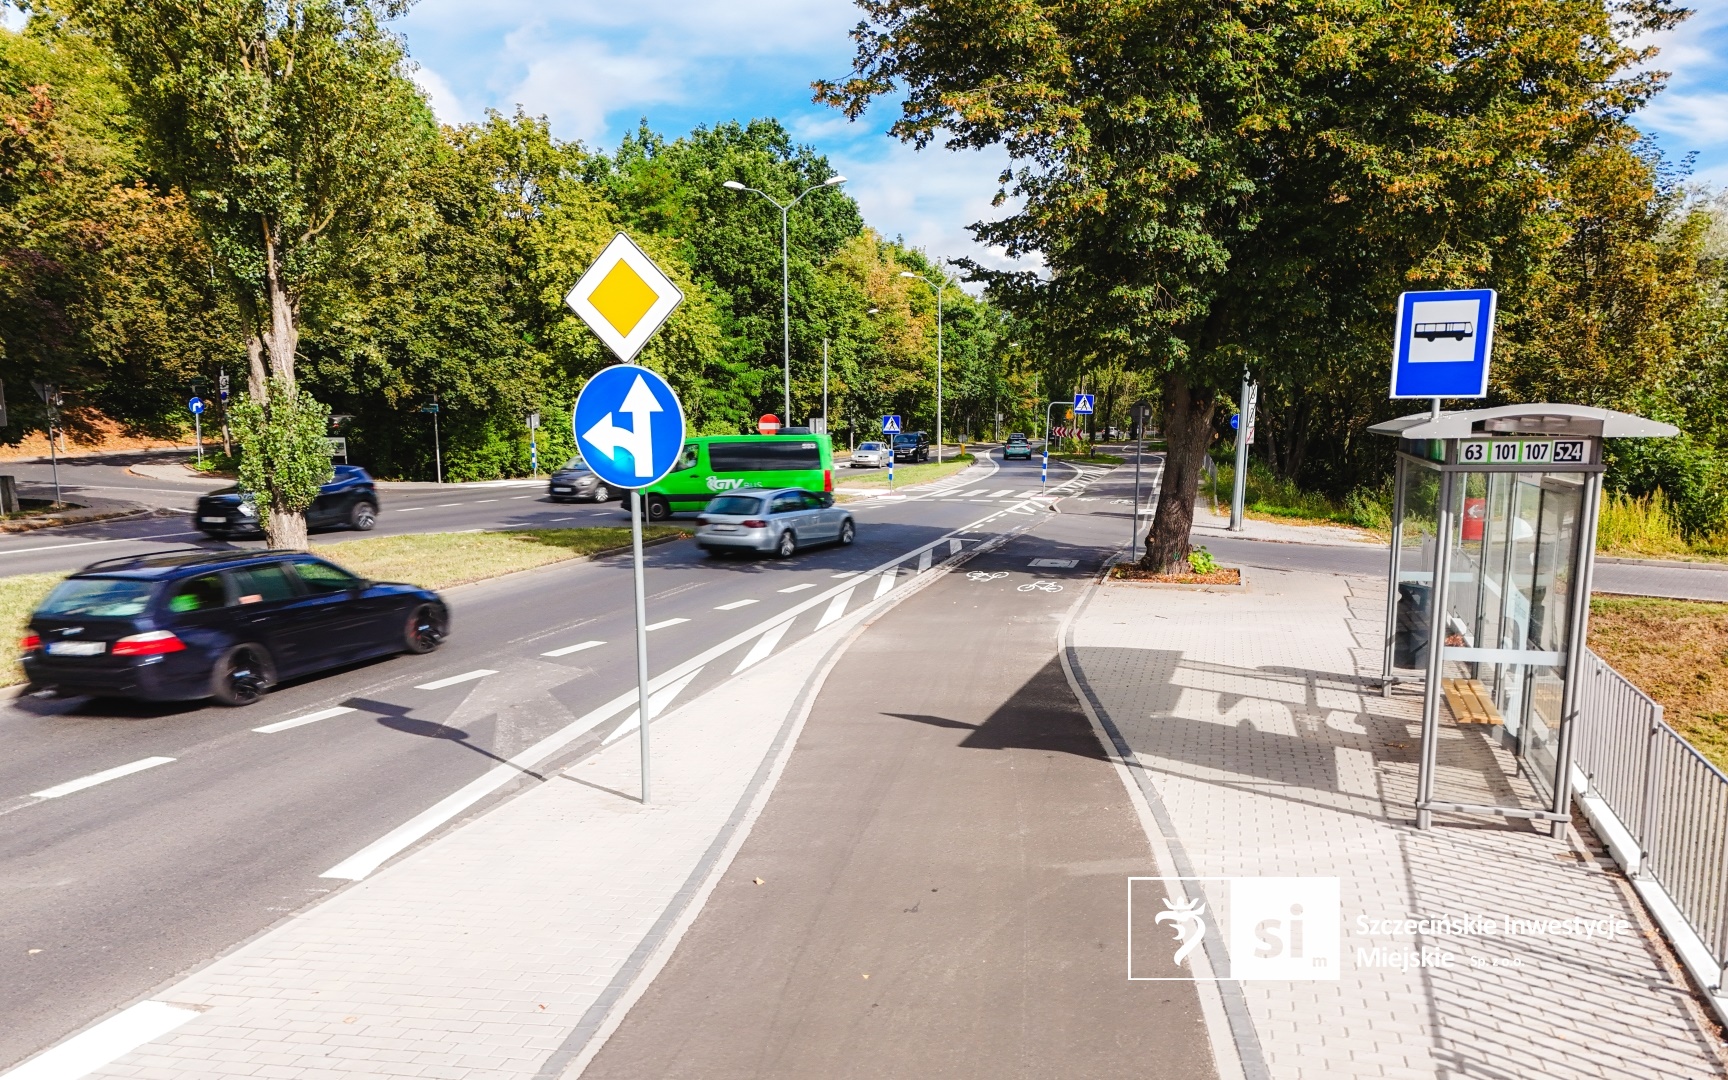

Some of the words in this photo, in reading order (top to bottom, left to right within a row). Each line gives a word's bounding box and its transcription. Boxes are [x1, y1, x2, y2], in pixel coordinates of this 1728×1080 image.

[1465, 444, 1483, 460] 63
[1495, 444, 1517, 460] 101
[1525, 444, 1549, 460] 107
[1554, 443, 1582, 460] 524
[716, 478, 744, 490] GTV
